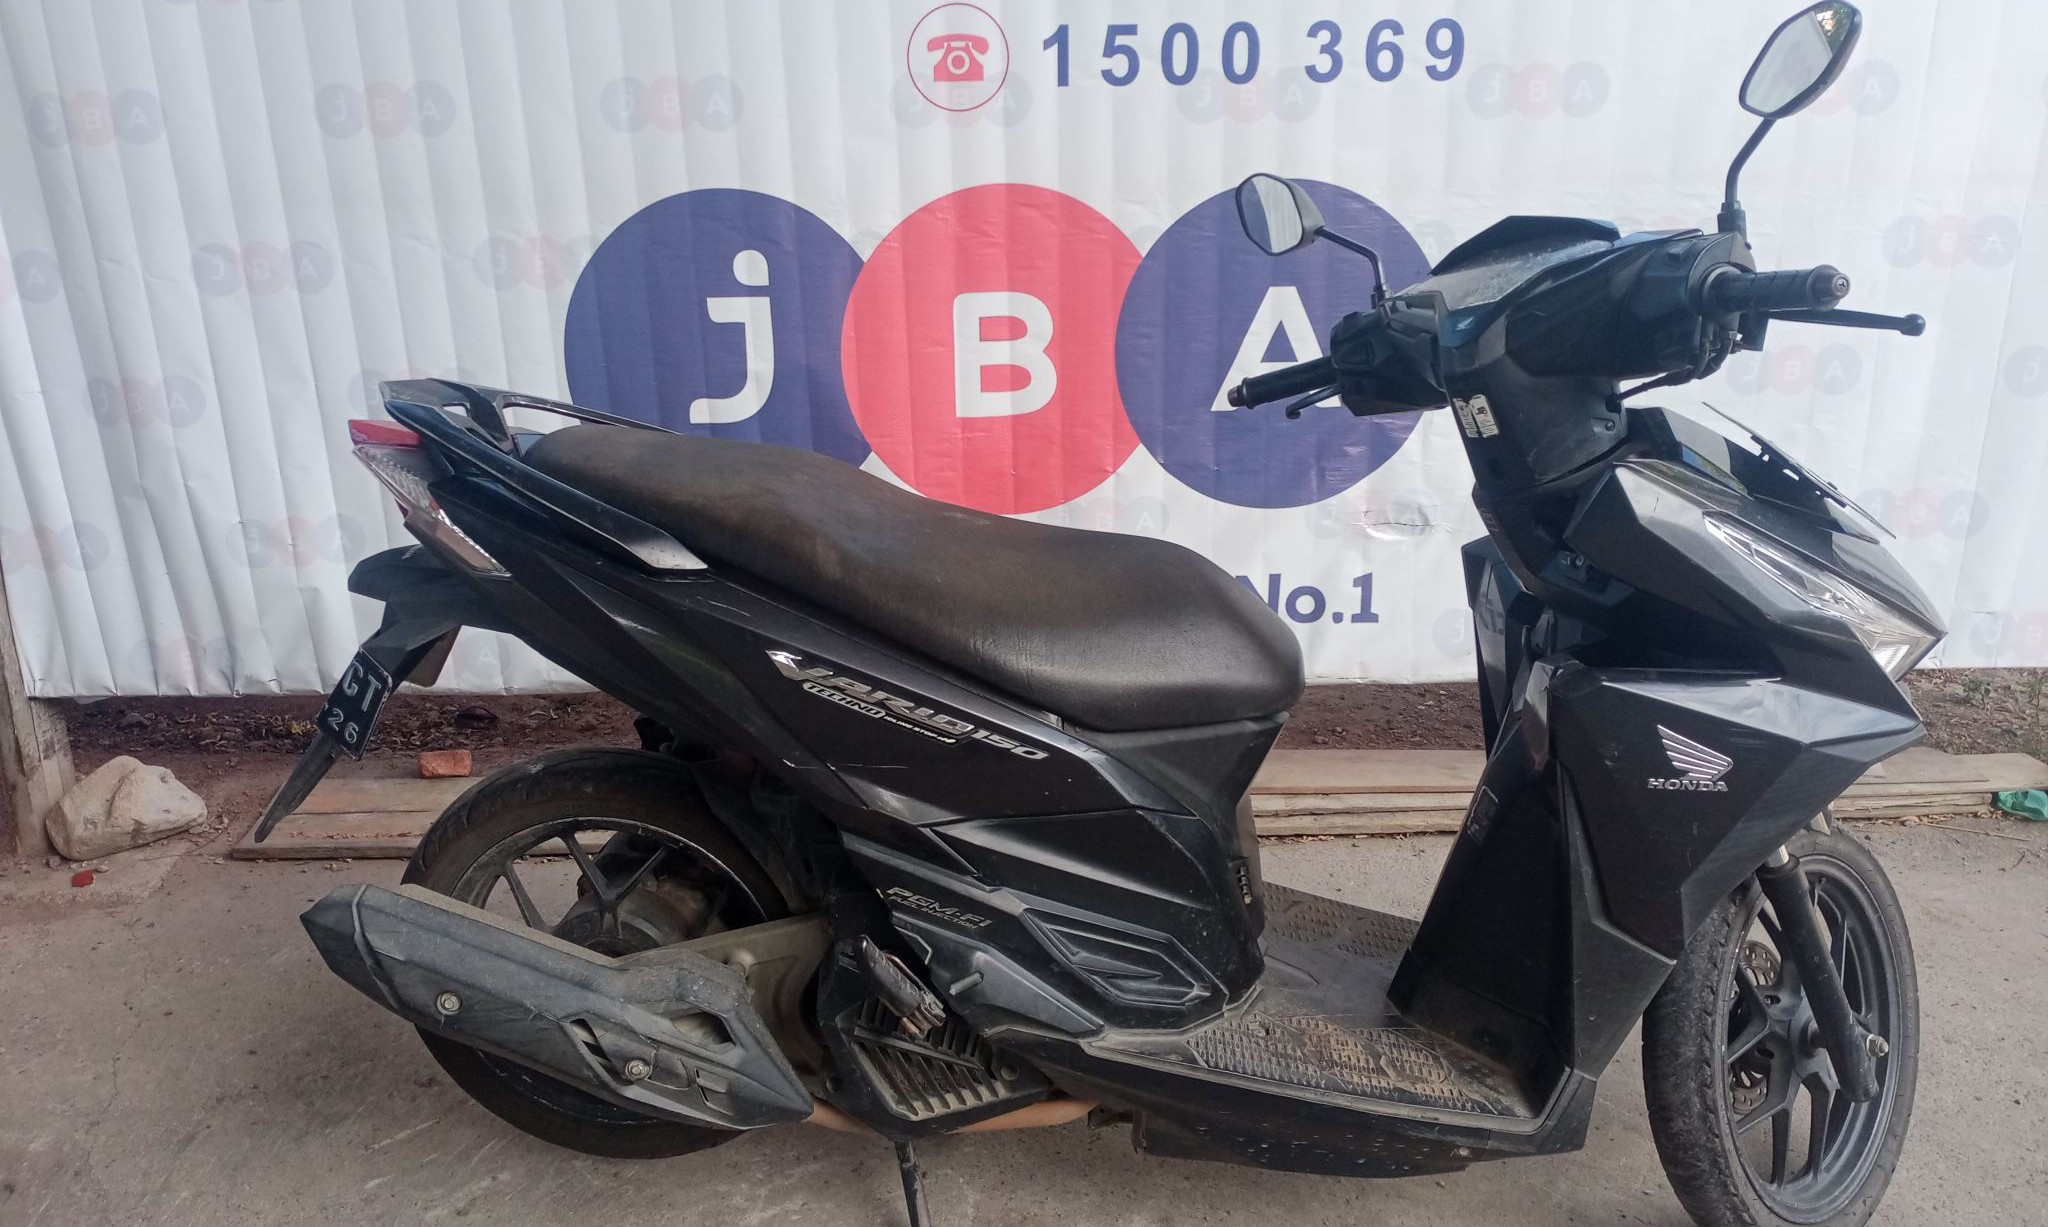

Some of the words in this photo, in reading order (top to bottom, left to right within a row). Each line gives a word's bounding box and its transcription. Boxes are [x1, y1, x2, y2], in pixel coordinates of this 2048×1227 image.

[1042, 20, 1261, 88] 1500
[1304, 17, 1466, 84] 369
[1235, 572, 1379, 625] No.1
[804, 682, 886, 719] TECHNO
[970, 729, 1049, 760] 150
[1647, 778, 1729, 792] HONDA
[886, 886, 993, 928] PGM-FI
